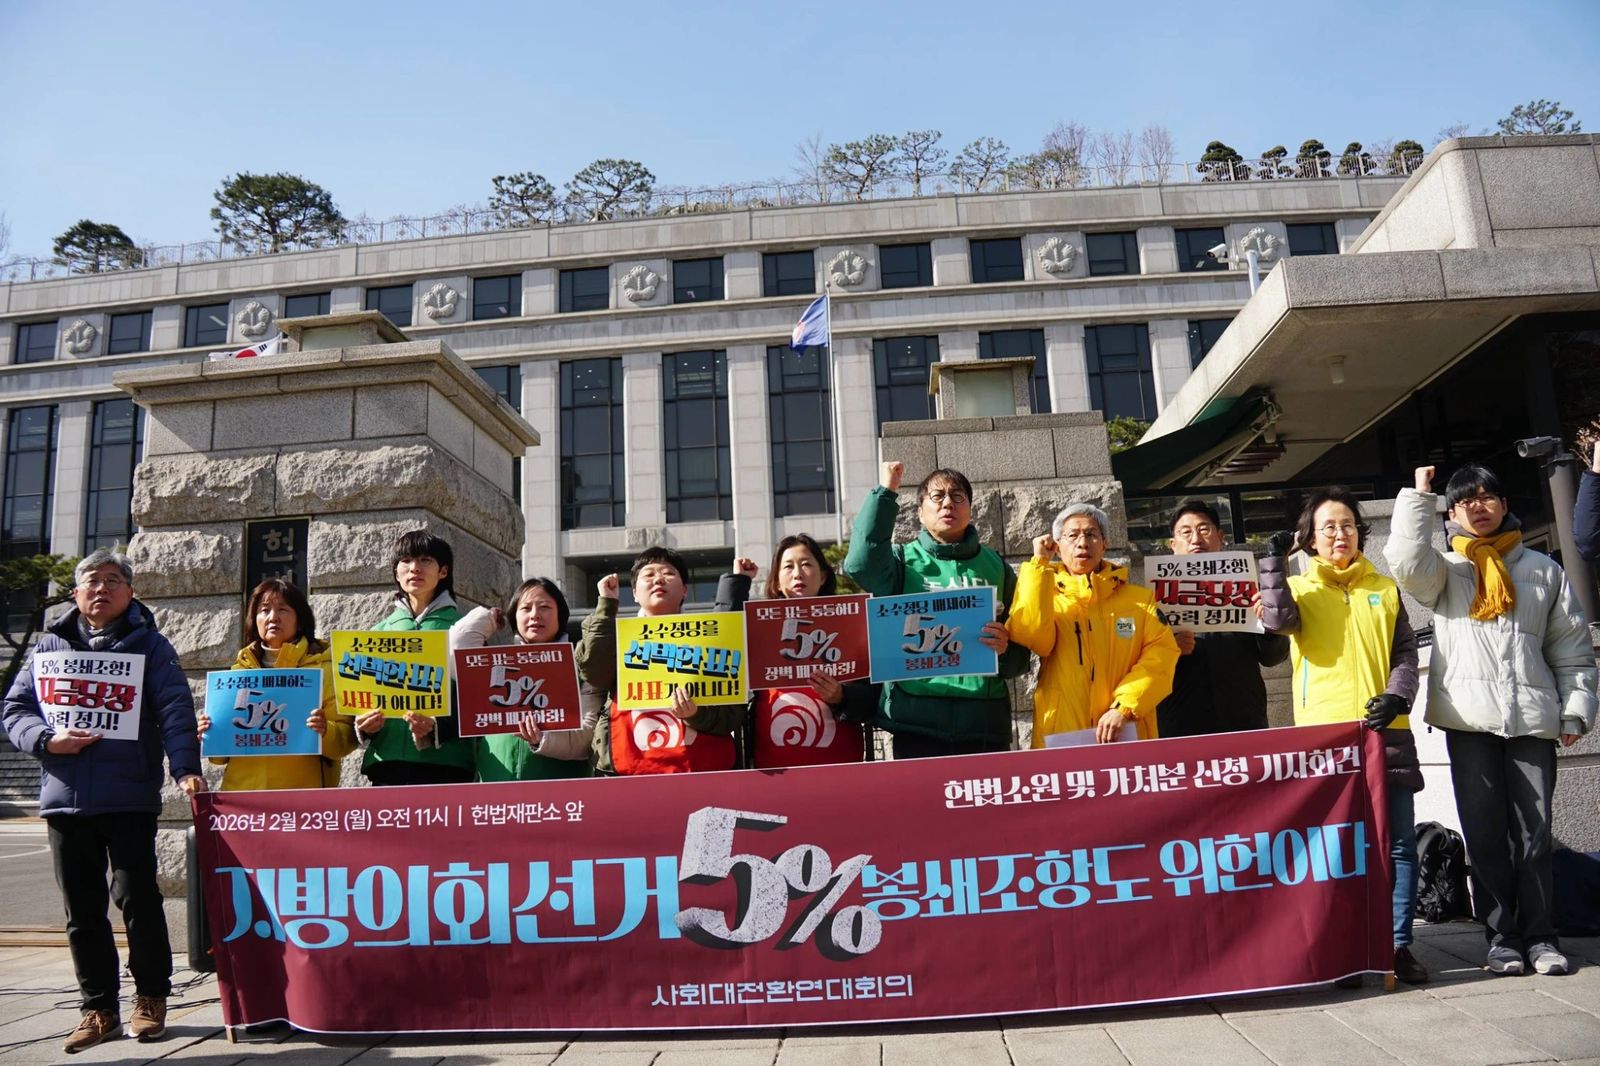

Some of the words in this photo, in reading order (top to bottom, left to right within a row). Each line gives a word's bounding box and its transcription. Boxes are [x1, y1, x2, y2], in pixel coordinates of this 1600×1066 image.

[1157, 562, 1182, 578] 5%
[1186, 558, 1249, 577] 봉쇄조항!
[1150, 579, 1258, 608] 지금당장
[756, 607, 782, 621] 모든
[784, 606, 808, 619] 표는
[810, 602, 860, 617] 동등하다
[876, 600, 929, 618] 소수정당
[932, 595, 985, 612] 배제하는
[1165, 610, 1199, 626] 효력
[1204, 608, 1247, 626] 정지!
[638, 619, 719, 640] 소수정당을
[902, 613, 963, 656] 5%
[350, 637, 424, 653] 소수정당을
[779, 619, 842, 663] 5%
[41, 660, 60, 675] 5%
[63, 659, 131, 677] 봉쇄조항!
[465, 654, 489, 668] 모든
[492, 653, 515, 666] 표는
[516, 650, 563, 664] 동등하다
[624, 640, 704, 675] 선택한
[702, 646, 742, 679] 표!
[905, 654, 961, 671] 봉쇄조항
[216, 675, 259, 690] 소수정당
[262, 675, 313, 689] 배제하는
[338, 652, 408, 689] 선택한
[407, 662, 444, 694] 표!
[765, 665, 793, 681] 장벽
[38, 677, 137, 712] 지금당장
[488, 665, 549, 709] 5%
[625, 680, 679, 701] 사표가
[684, 680, 740, 698] 아니다!
[342, 690, 388, 710] 사표가
[391, 694, 442, 710] 아니다!
[74, 711, 119, 731] 정지!
[232, 688, 289, 734] 5%
[475, 712, 502, 728] 장벽
[235, 733, 288, 748] 봉쇄조항
[944, 772, 1061, 809] 헌법소원
[1066, 770, 1095, 800] 및
[1100, 762, 1188, 797] 가처분
[1192, 757, 1249, 789] 신청
[1253, 746, 1361, 782] 기자회견
[208, 813, 266, 832] 2026년
[269, 811, 297, 832] 2월
[300, 810, 339, 832] 23일
[343, 809, 372, 832] (월)
[376, 807, 411, 829] 오전
[414, 805, 449, 828] 11시
[471, 802, 562, 825] 헌법재판소
[565, 800, 585, 823] 앞
[214, 856, 682, 949] 지방의회선거
[673, 806, 883, 961] 5%
[861, 844, 1153, 921] 봉쇄조항도
[1159, 821, 1371, 897] 위헌이다
[651, 975, 913, 1007] 사회대전환연대회의
